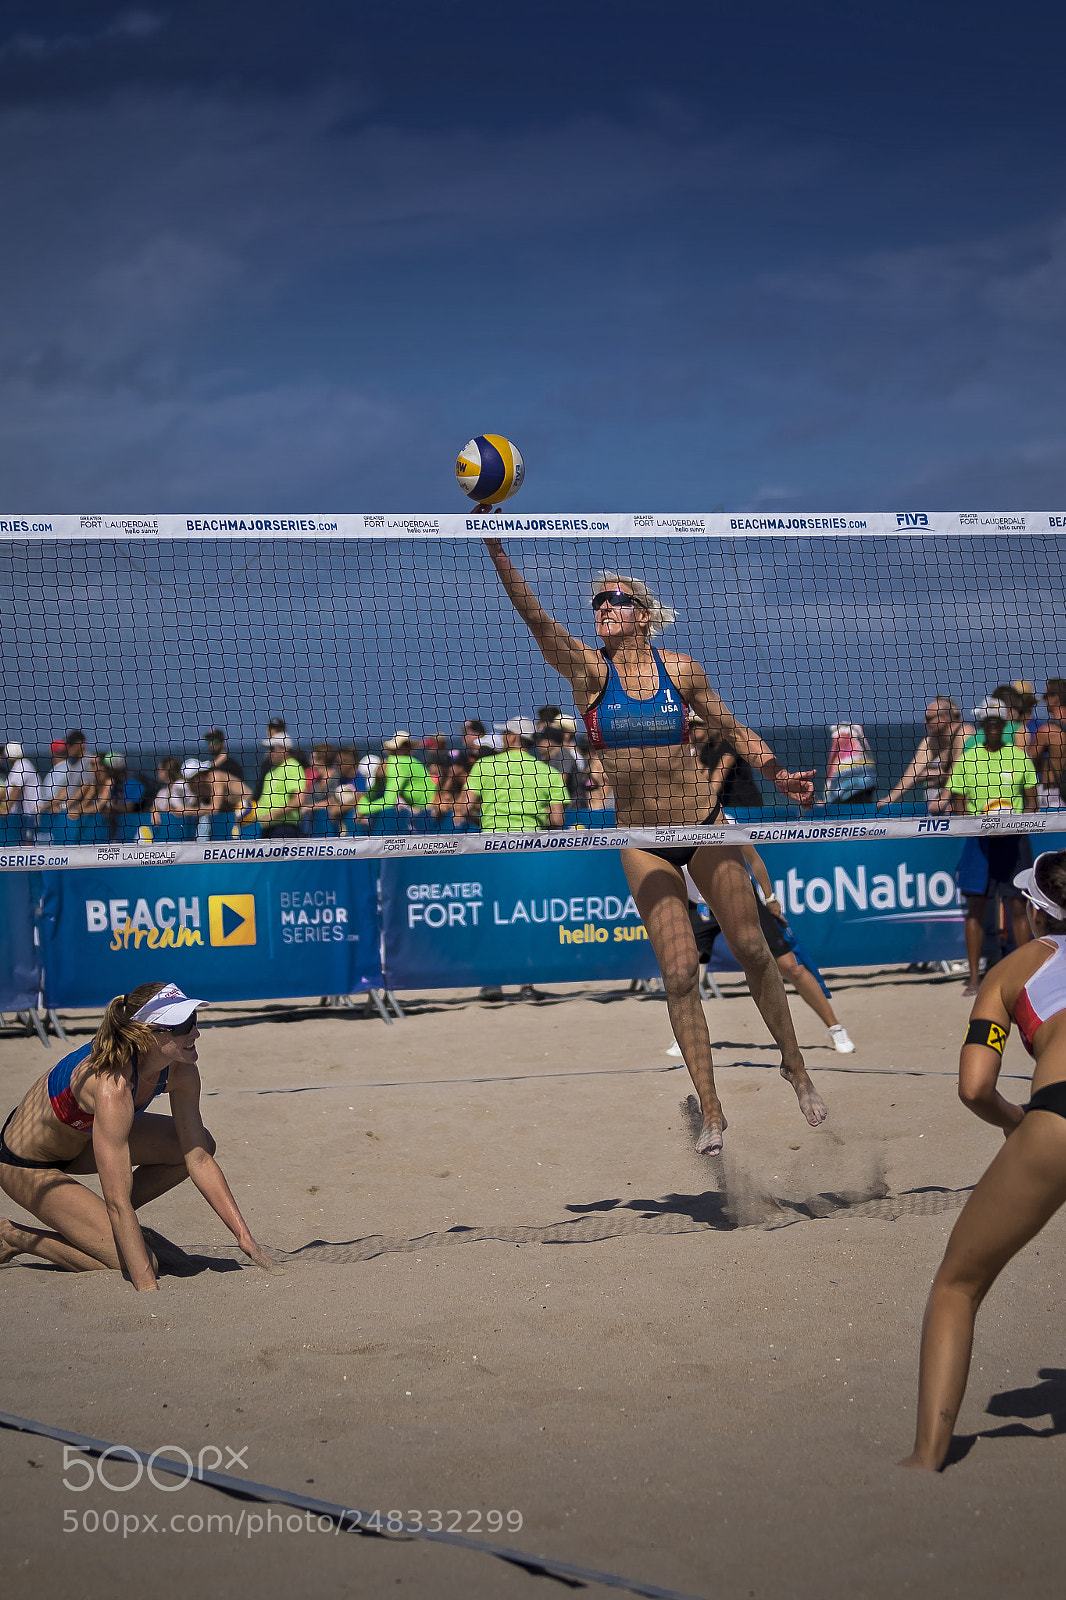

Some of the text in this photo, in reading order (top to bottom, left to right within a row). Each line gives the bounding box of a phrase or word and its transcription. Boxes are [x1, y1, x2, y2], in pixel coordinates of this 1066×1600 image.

[80, 520, 158, 529] FORT LAUDERDALE
[186, 519, 338, 531] BEACHMAJORSERIES.COM
[364, 520, 439, 529] FORT LAUDERDALE
[466, 519, 610, 531] BEACHMAJORSERIES.COM
[634, 519, 706, 527] FORT LAUDERDALE
[730, 518, 867, 530] BEACHMAJORSERIES.COM
[896, 513, 930, 526] FIVB
[960, 517, 1026, 525] FORT LAUDERDALE
[663, 688, 674, 703] 1
[660, 704, 679, 713] USA
[918, 819, 950, 832] FIVB
[1001, 820, 1047, 829] LAUDERDALE
[655, 832, 726, 843] FORT LAUDERDALE
[749, 827, 887, 840] BEACHMAJORSERIES.COM
[383, 841, 459, 852] FORT LAUDERDALE
[484, 836, 629, 850] BEACHMAJORSERIES.COM
[97, 851, 176, 861] FORT LAUDERDALE
[203, 845, 357, 861] BEACHMAJORSERIES.COM
[406, 881, 483, 900] GREATER
[774, 862, 961, 915] toNatio
[280, 890, 336, 908] BEACH
[85, 897, 201, 932] BEACH
[281, 907, 348, 926] MAJOR
[407, 895, 641, 928] FORT LAUDERDA
[110, 916, 204, 951] stream
[559, 924, 649, 945] hello sun
